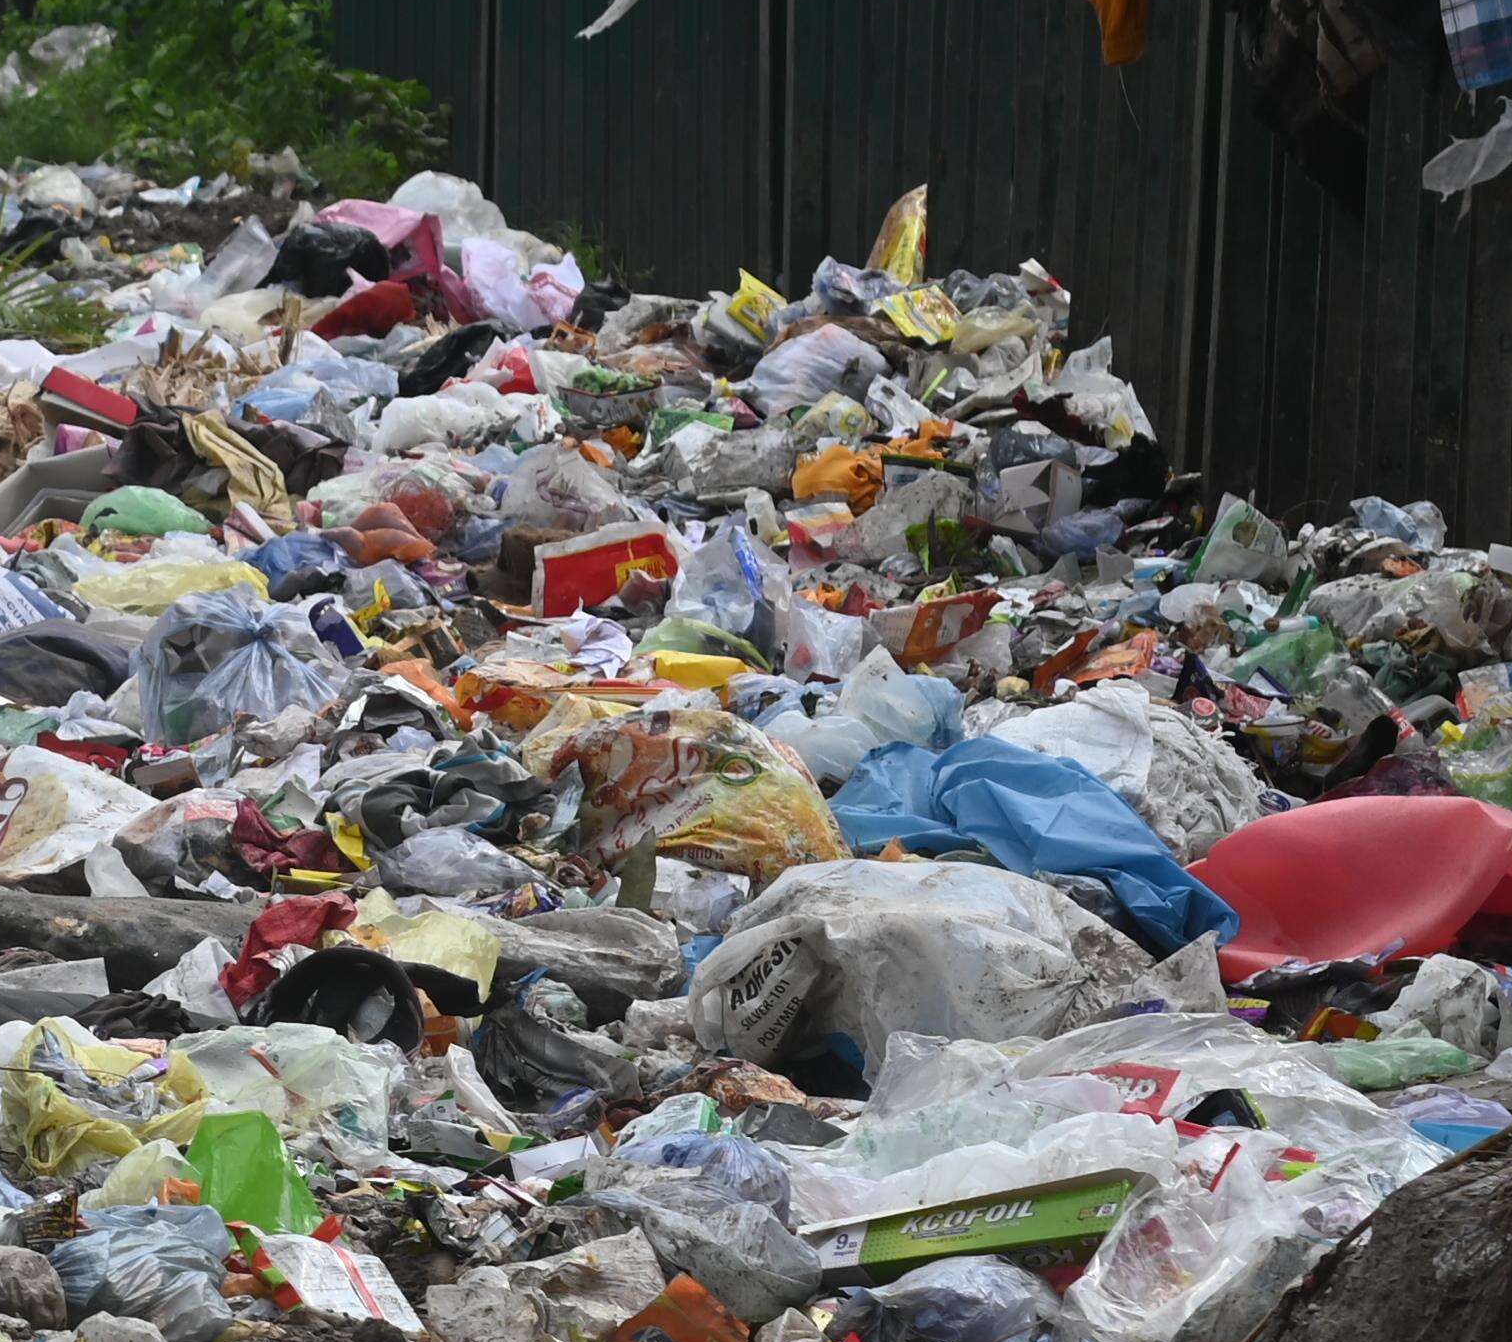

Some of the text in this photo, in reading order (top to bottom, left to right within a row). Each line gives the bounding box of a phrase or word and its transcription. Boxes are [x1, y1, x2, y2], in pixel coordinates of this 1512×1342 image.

[740, 978, 791, 1031] SILVER-101
[756, 995, 802, 1048] POLYMER
[900, 1200, 1034, 1235] KCOFOIL
